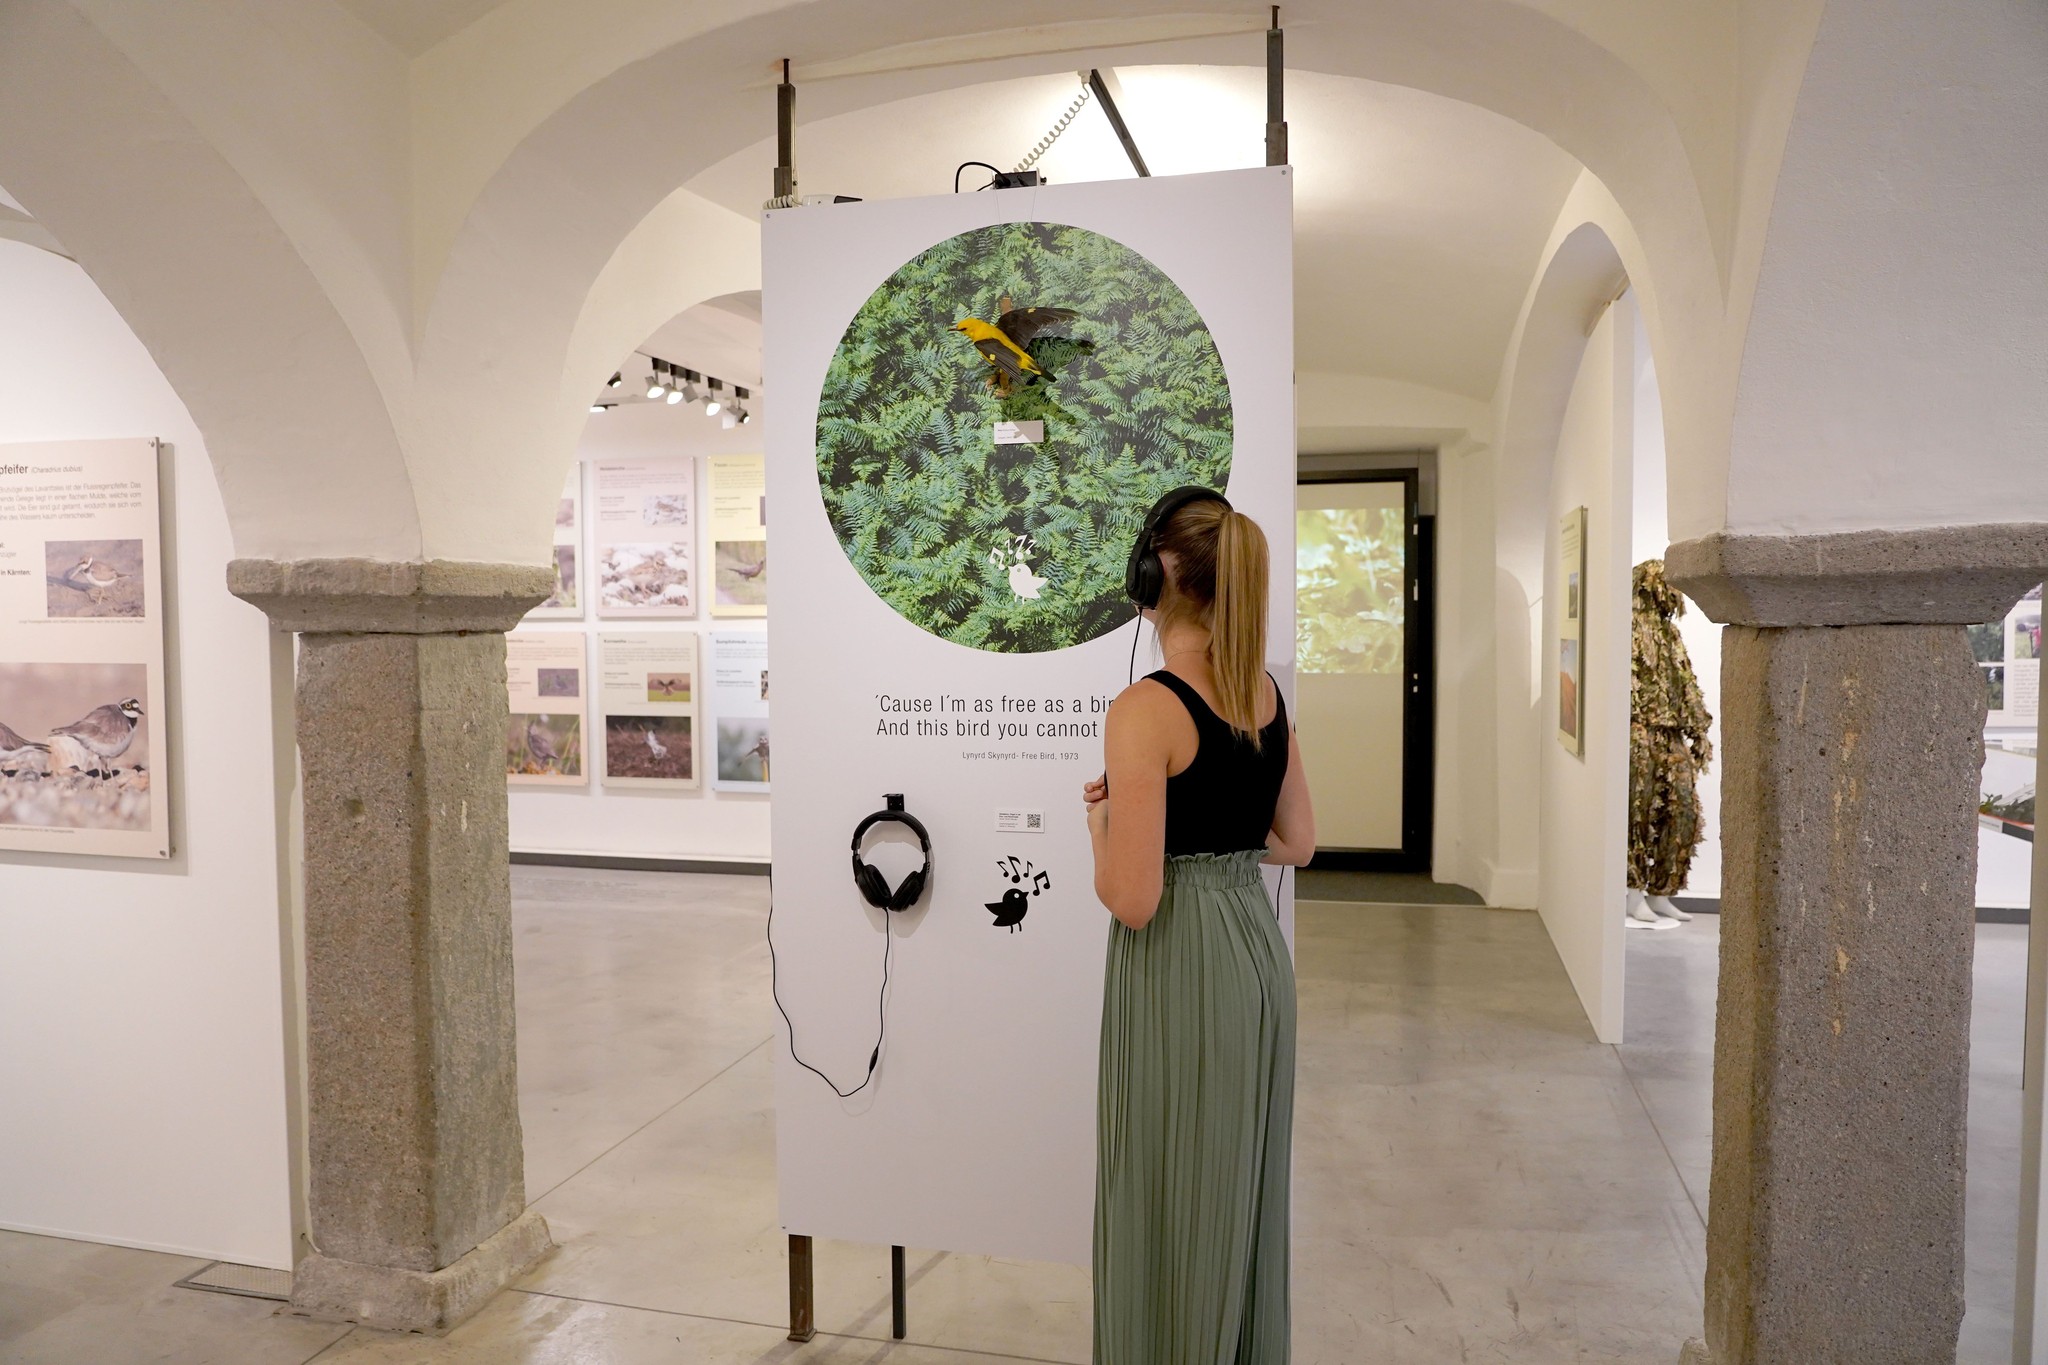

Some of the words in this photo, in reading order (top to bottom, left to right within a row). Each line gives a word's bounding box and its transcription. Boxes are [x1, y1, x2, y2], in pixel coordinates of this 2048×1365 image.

[974, 699, 993, 713] as
[1001, 695, 1036, 713] free
[1044, 699, 1064, 713] as
[1072, 699, 1082, 713] a
[1091, 696, 1115, 713] bir
[876, 719, 909, 736] And
[917, 719, 948, 736] this
[956, 719, 990, 736] bird
[998, 723, 1028, 740] you
[1036, 721, 1098, 737] cannot
[962, 751, 986, 760] Lynyrd
[1021, 751, 1038, 760] Free
[1040, 752, 1057, 760] Bird,
[1060, 752, 1079, 760] 1973
